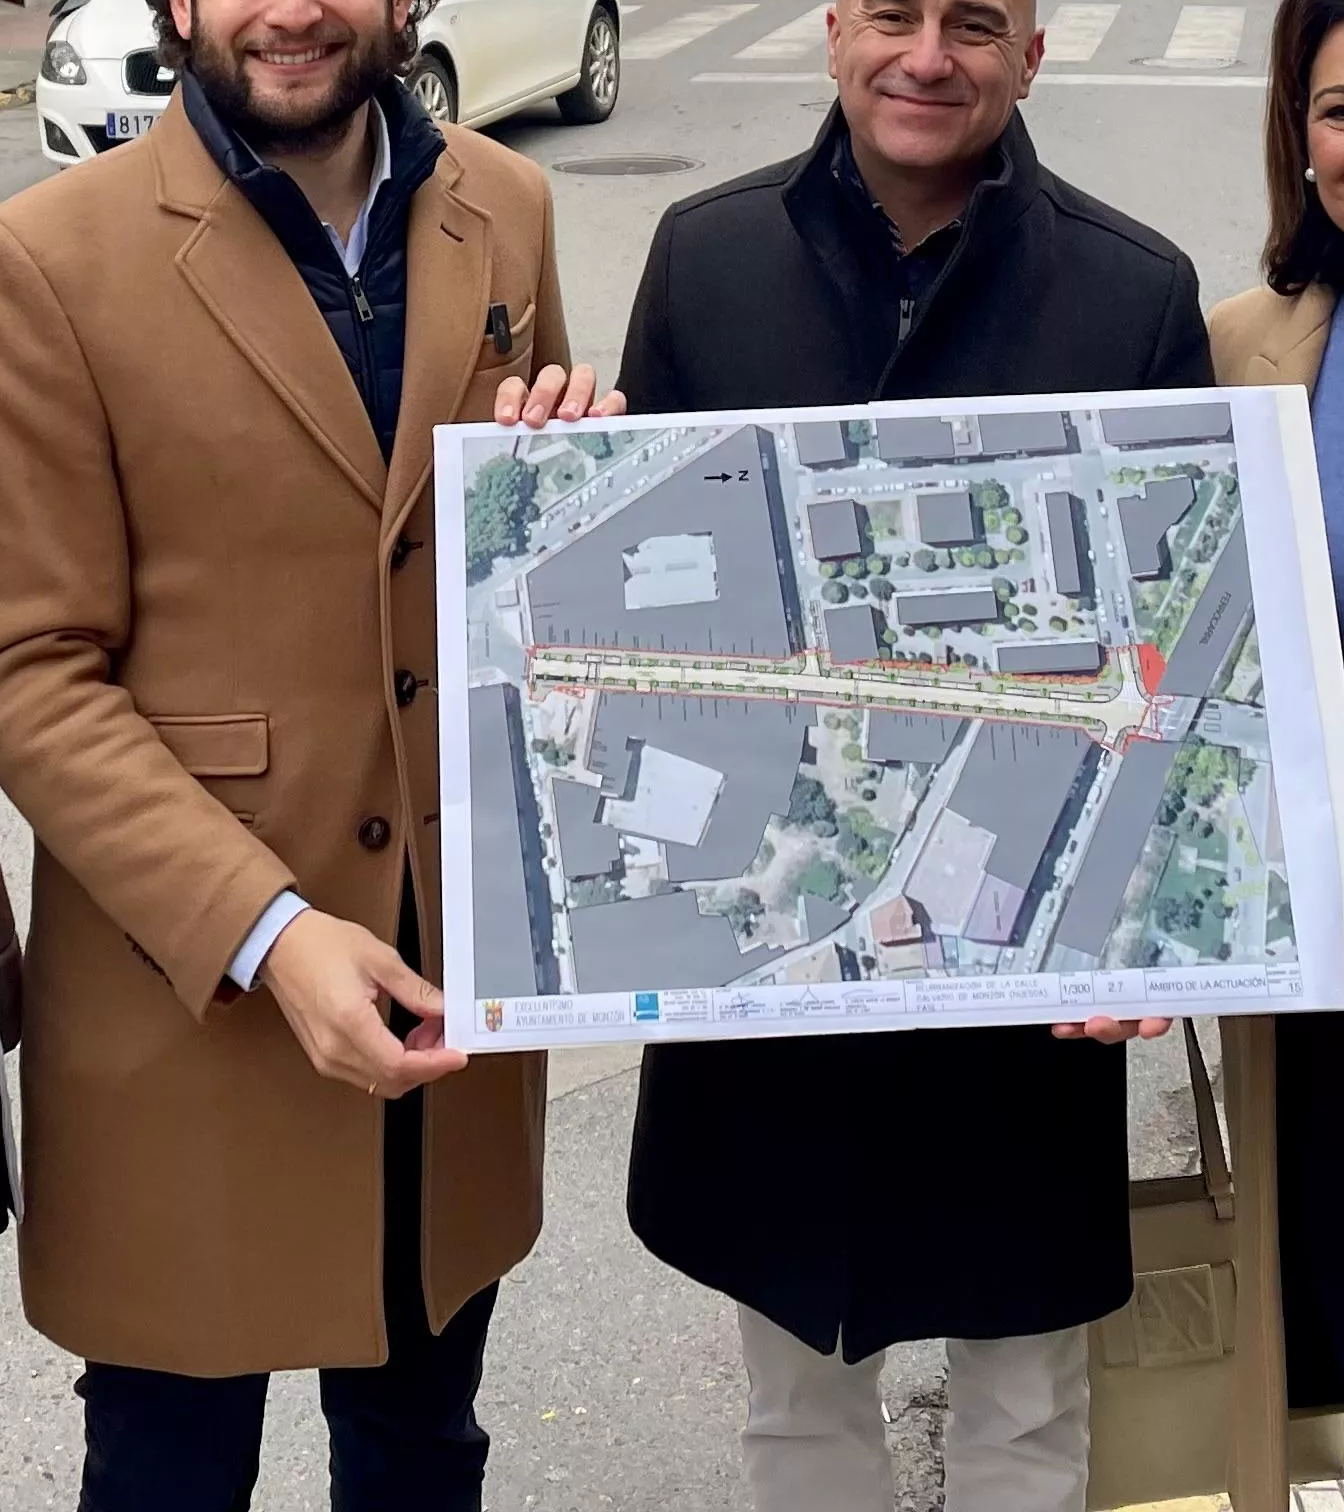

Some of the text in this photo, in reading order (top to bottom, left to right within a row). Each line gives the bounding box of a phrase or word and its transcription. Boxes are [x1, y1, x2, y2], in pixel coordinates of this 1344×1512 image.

[119, 115, 160, 135] 817
[1000, 981, 1011, 989] LA
[1014, 979, 1039, 989] CALLE
[1063, 983, 1091, 994] 1/300
[1149, 977, 1266, 992] ÁMBITO DE LA ACTUACIÓN
[1289, 982, 1302, 993] 15
[516, 1012, 575, 1027] AYUNTAMIENTO
[578, 1012, 588, 1024] DE
